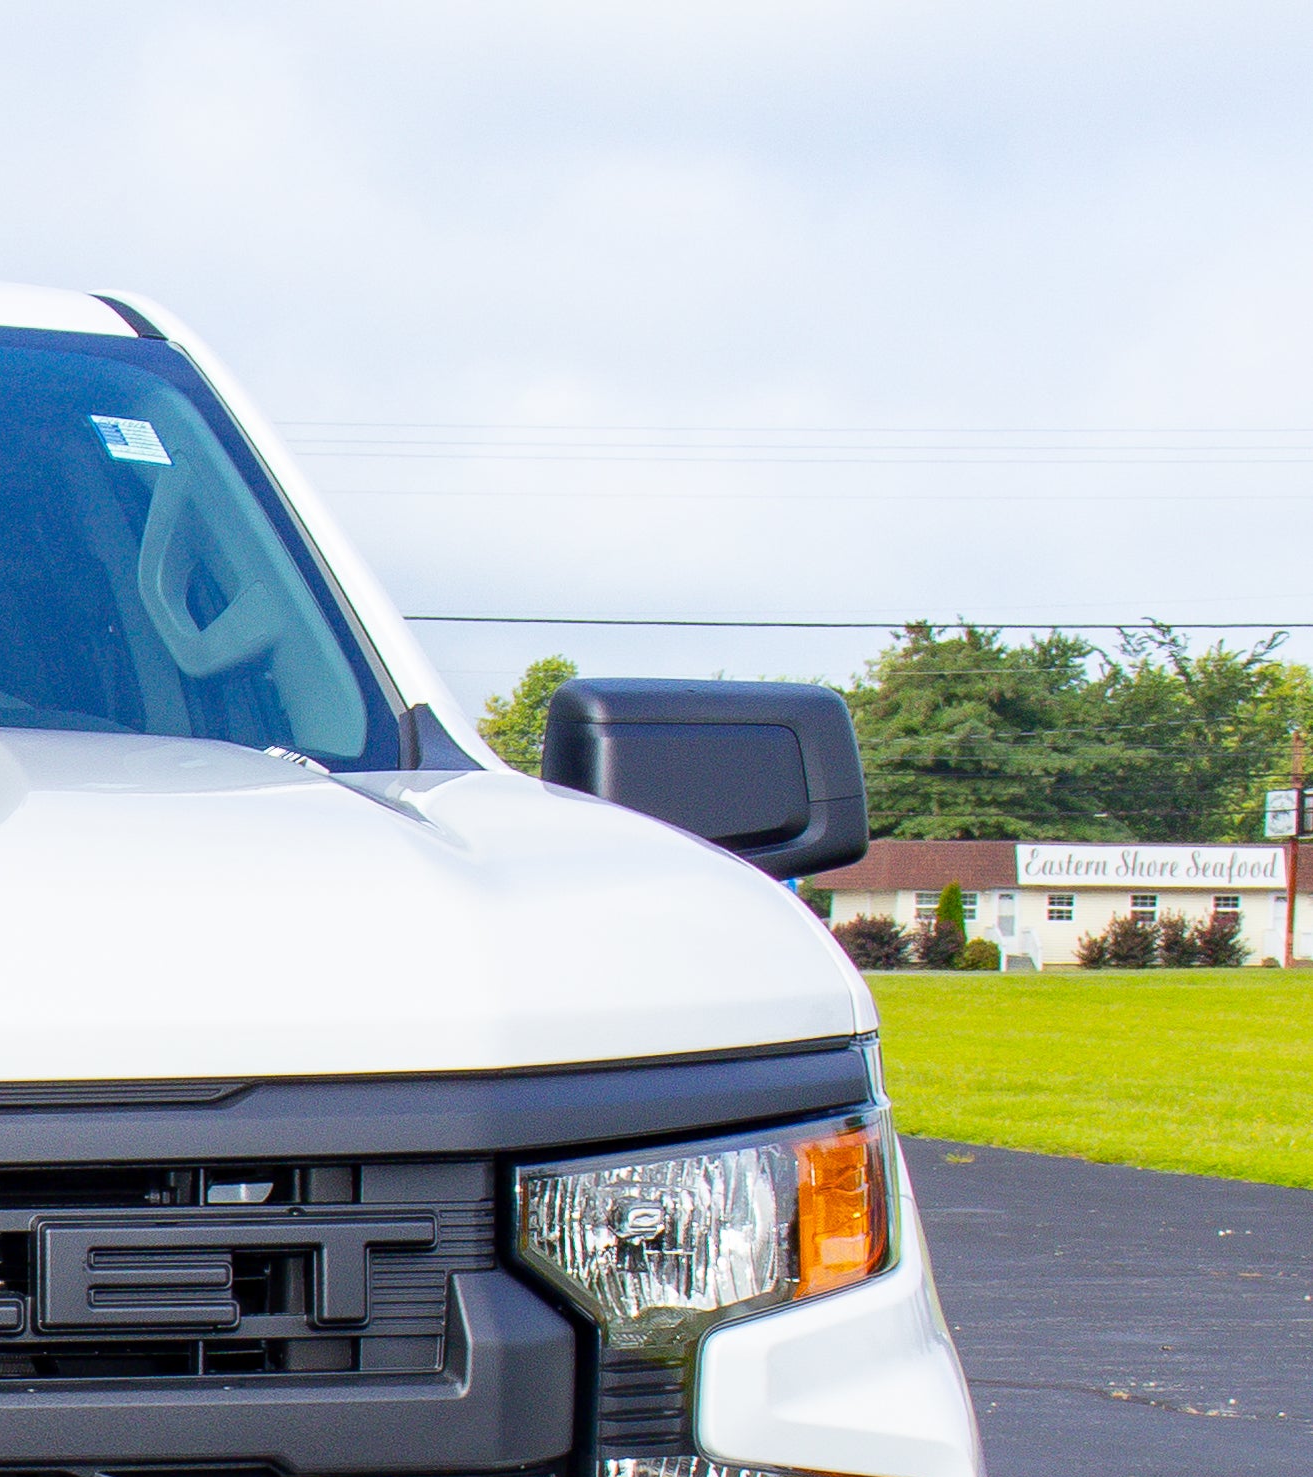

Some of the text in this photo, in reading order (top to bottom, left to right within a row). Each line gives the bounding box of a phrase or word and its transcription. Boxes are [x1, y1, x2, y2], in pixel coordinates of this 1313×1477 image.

[1025, 848, 1278, 884] Eastern Shore Seafood
